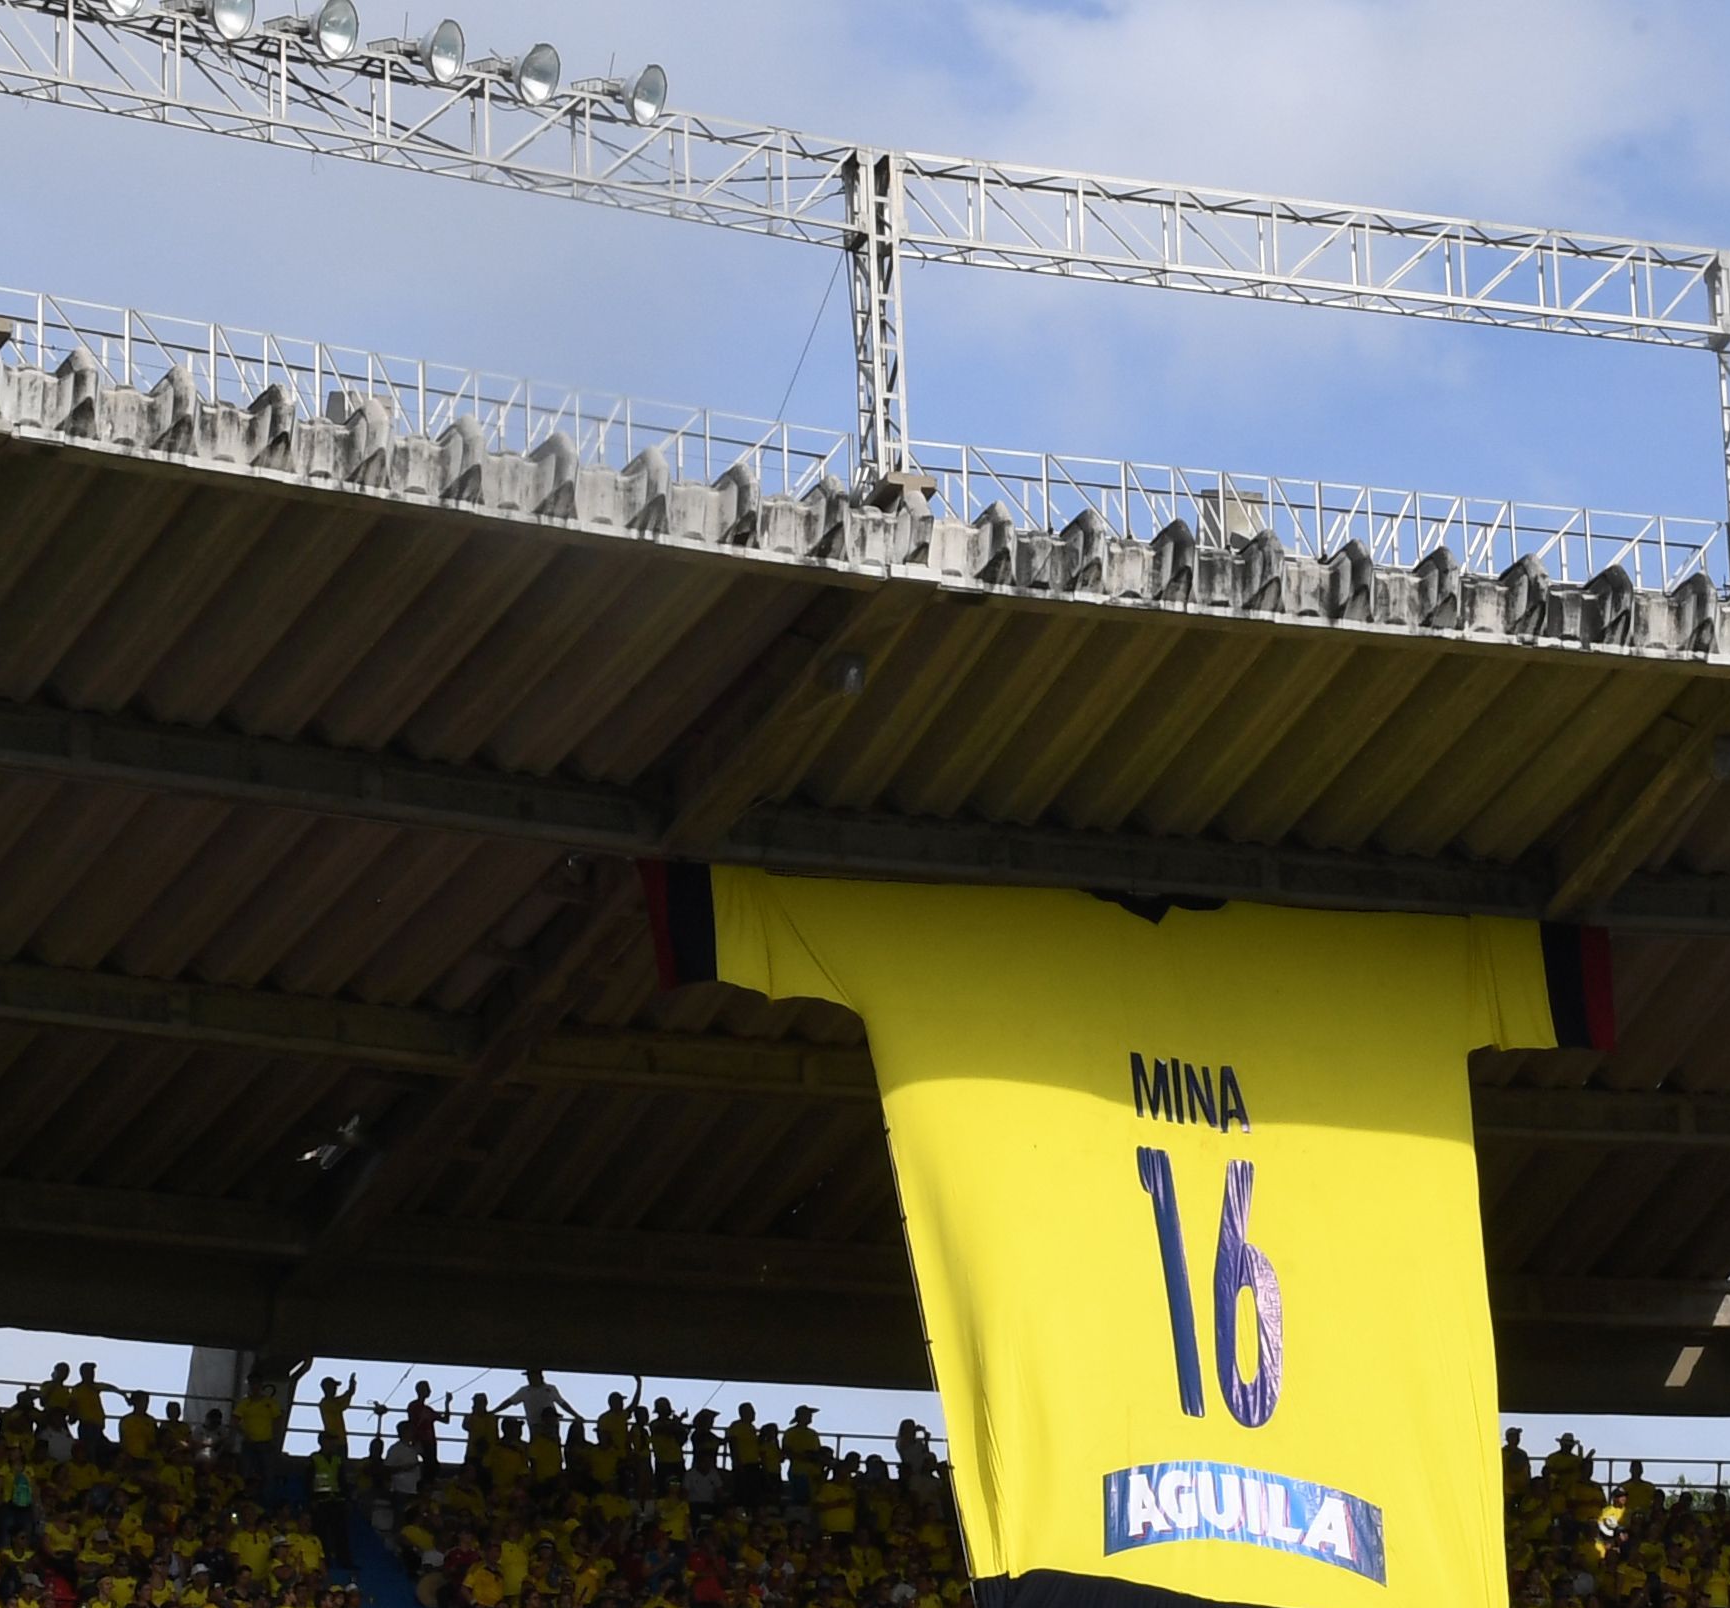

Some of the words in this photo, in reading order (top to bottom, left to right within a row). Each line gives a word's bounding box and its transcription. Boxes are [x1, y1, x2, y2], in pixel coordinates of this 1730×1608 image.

[1130, 1051, 1251, 1134] MINA
[1137, 1146, 1283, 1428] 16
[1127, 1471, 1356, 1562] AGUILA
